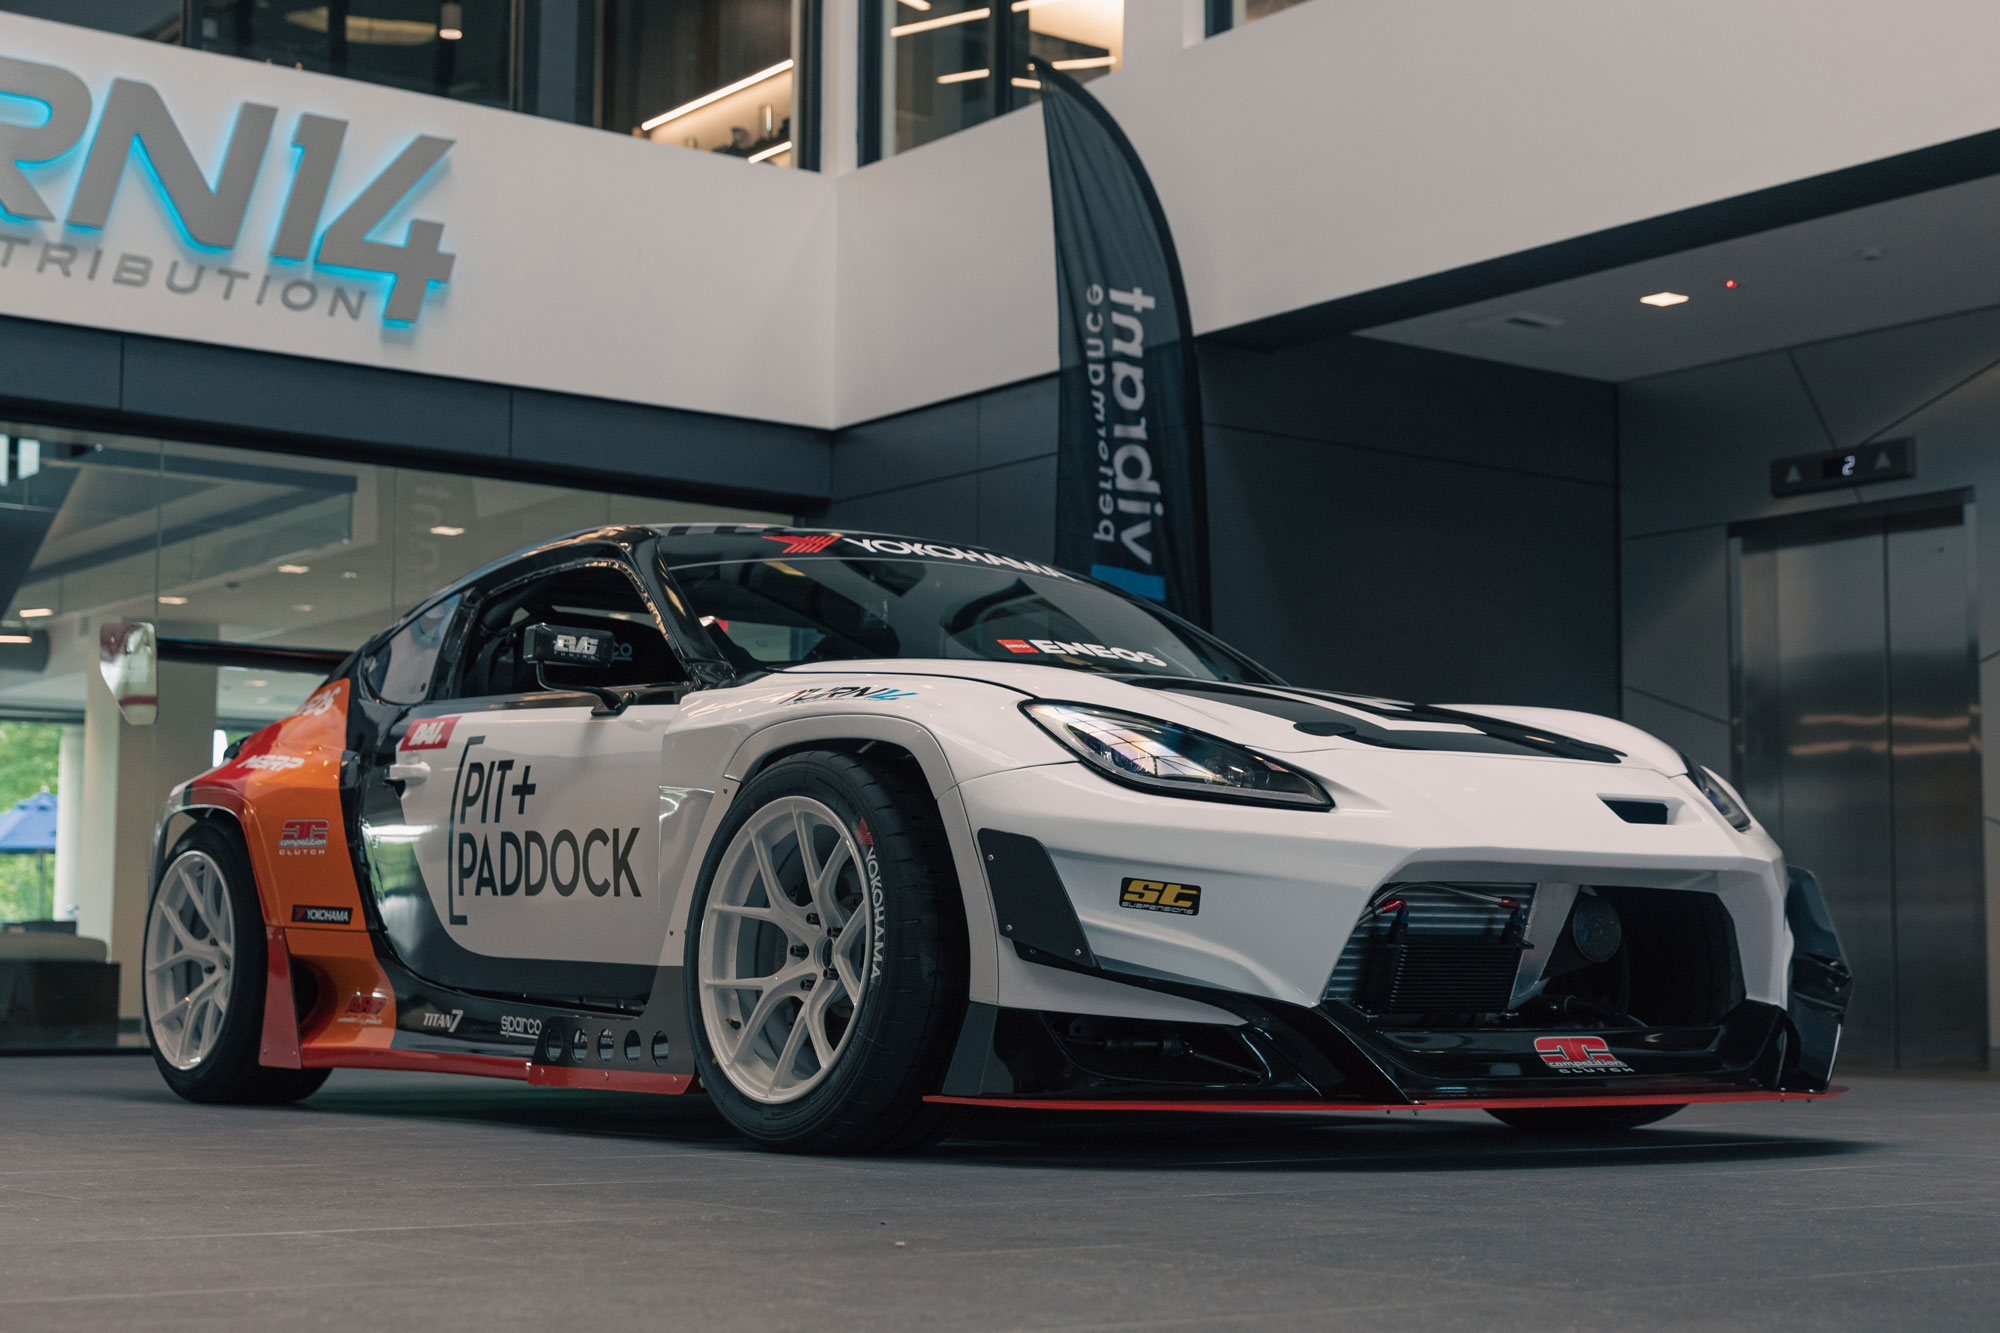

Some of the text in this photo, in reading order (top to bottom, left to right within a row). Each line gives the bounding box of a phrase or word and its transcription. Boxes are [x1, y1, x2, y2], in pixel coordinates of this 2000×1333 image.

[0, 56, 457, 322] RN14
[0, 233, 367, 321] TRIBUTION
[1841, 455, 1856, 476] 2
[842, 537, 1078, 583] YOKOHAMA
[1028, 639, 1168, 668] ENEOS
[278, 848, 326, 856] CLUTCH
[457, 827, 642, 898] PADDOCK
[305, 907, 349, 922] YOKOHAMA
[865, 846, 885, 979] YOKOHAMA
[500, 1015, 542, 1038] sparco
